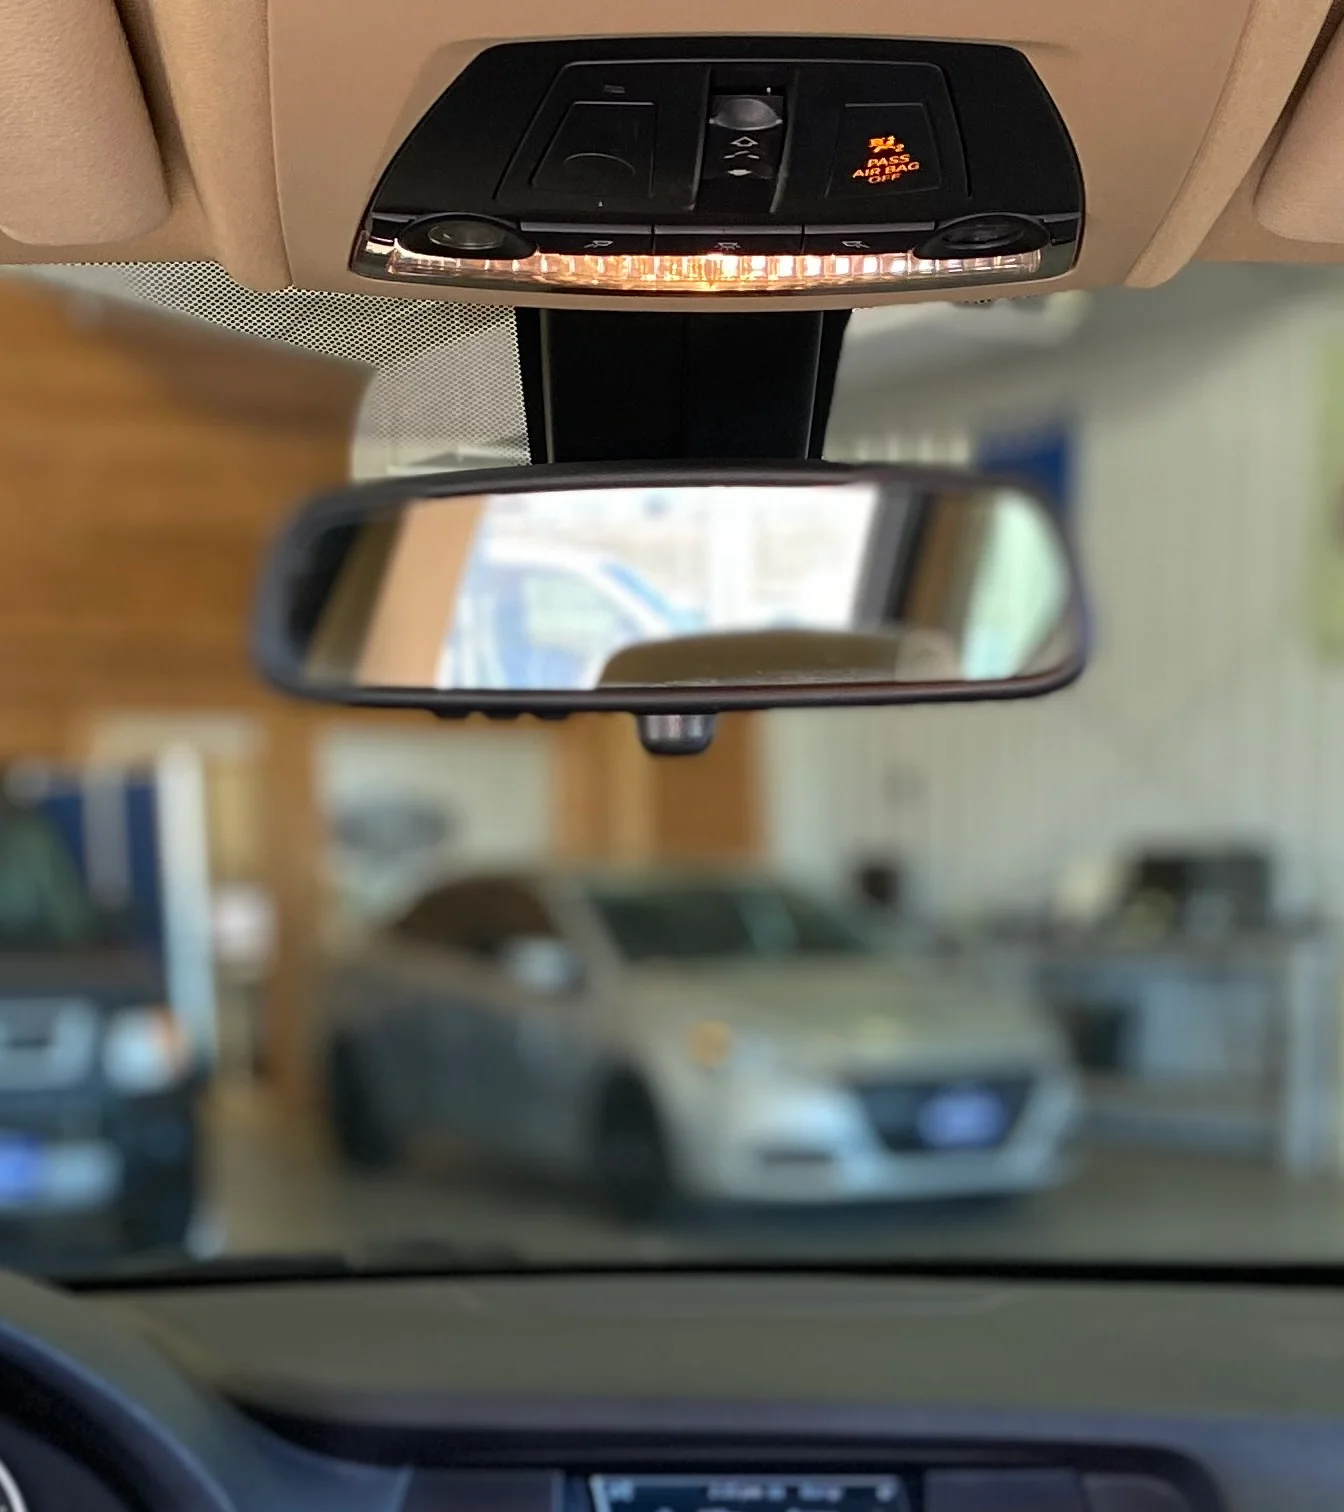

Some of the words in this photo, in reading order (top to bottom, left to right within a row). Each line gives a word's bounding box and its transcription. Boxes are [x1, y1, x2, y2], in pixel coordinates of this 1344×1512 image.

[867, 154, 910, 167] PASS
[852, 167, 881, 178] AIR
[885, 161, 920, 174] BAG
[868, 173, 902, 184] OFF
